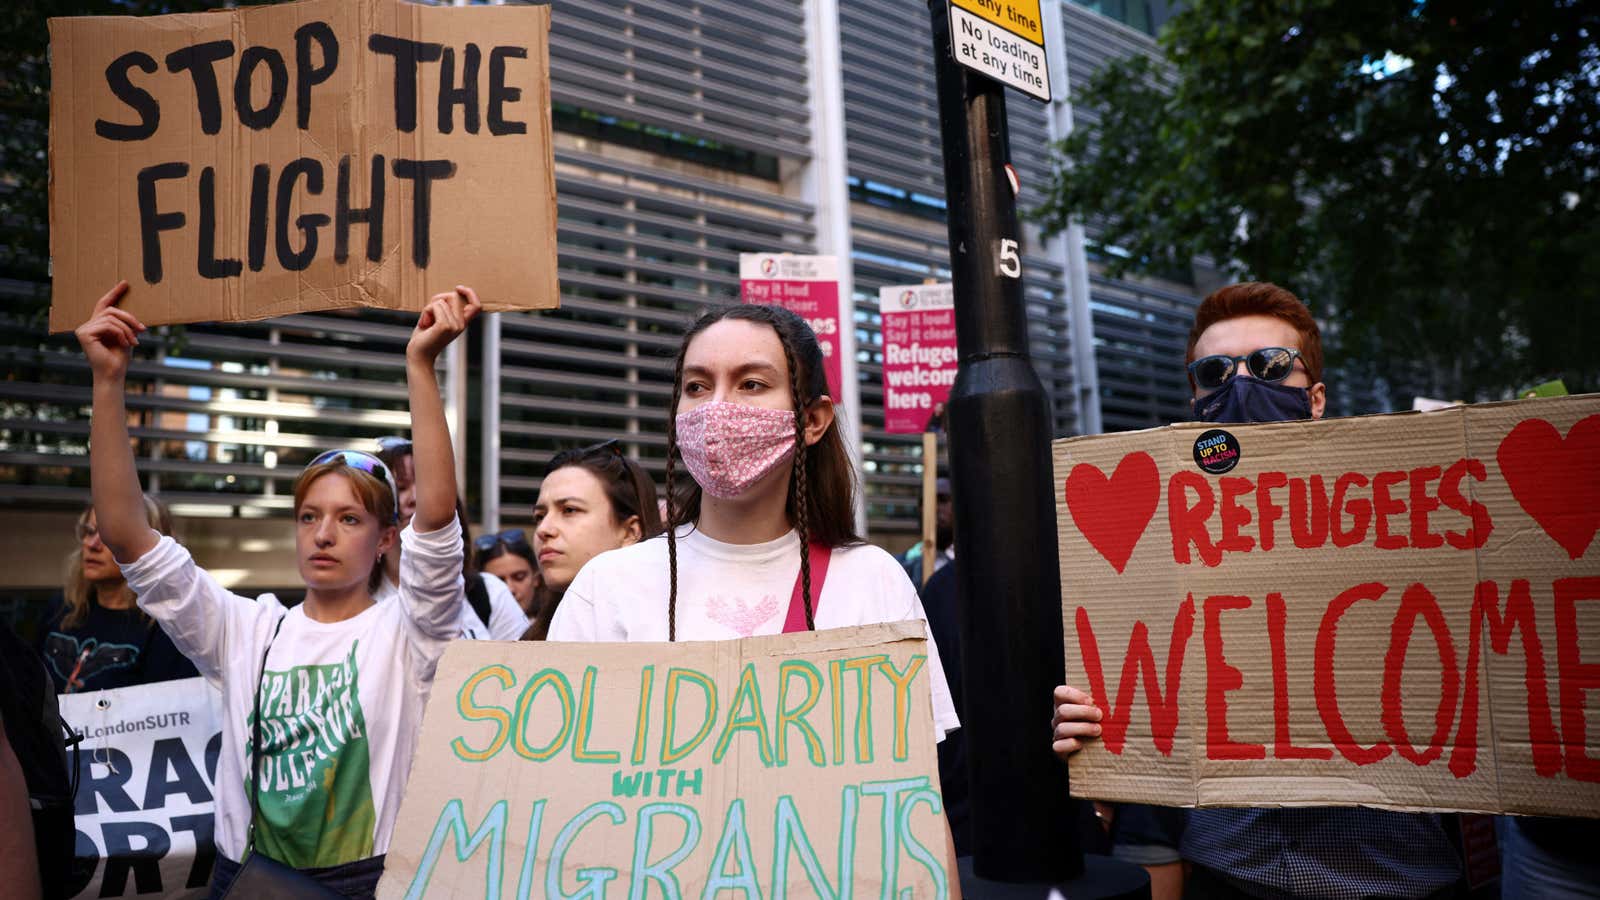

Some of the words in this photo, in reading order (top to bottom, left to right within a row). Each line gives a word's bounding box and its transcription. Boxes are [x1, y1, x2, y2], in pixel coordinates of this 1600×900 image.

[1007, 5, 1037, 32] time
[961, 17, 983, 40] No
[988, 30, 1039, 70] loading
[95, 21, 339, 141] STOP
[368, 33, 528, 137] THE
[962, 43, 977, 60] at
[982, 52, 1007, 75] any
[1012, 62, 1043, 88] time
[137, 154, 457, 285] FLIGHT
[1000, 238, 1021, 279] 5
[746, 281, 769, 298] Say
[771, 282, 782, 296] it
[886, 314, 908, 331] Say
[910, 312, 920, 326] it
[922, 311, 951, 326] loud
[886, 328, 908, 345] Say
[910, 328, 920, 341] it
[887, 388, 932, 409] here
[1197, 434, 1227, 450] STAND
[1200, 447, 1213, 458] UP
[1214, 443, 1227, 453] TO
[1202, 448, 1238, 466] RACISM
[1168, 458, 1494, 568] REFUGEES
[1075, 576, 1600, 783] WELCOME
[65, 711, 190, 740] hLondonSUTR
[451, 654, 927, 767] SOLIDARITY
[612, 767, 702, 798] WITH
[402, 776, 948, 900] MIGRANTS
